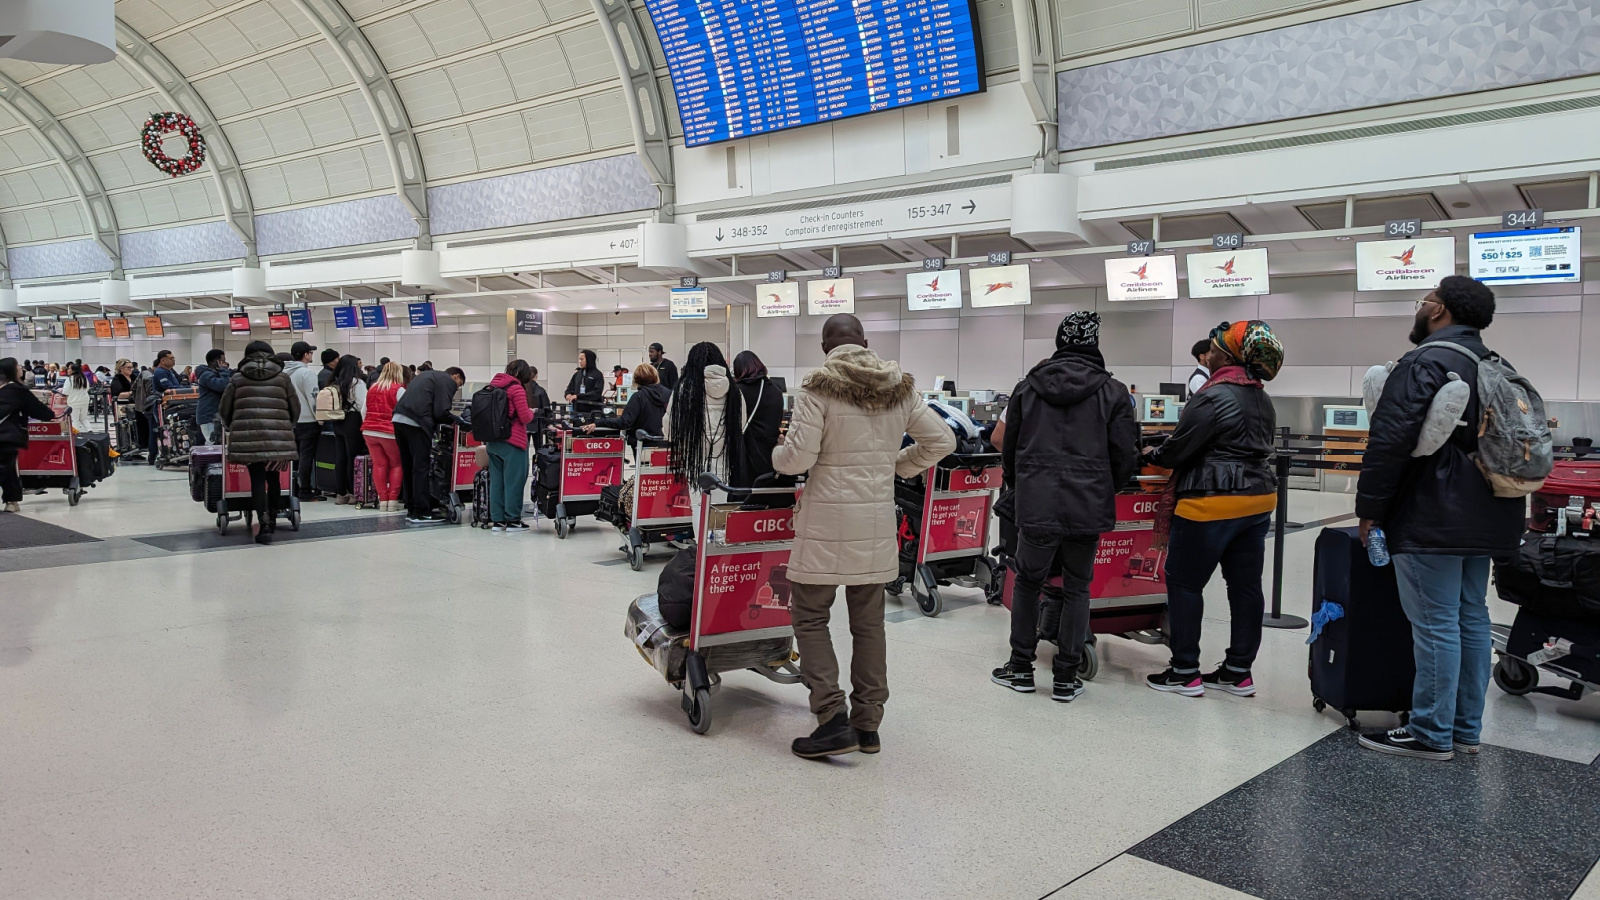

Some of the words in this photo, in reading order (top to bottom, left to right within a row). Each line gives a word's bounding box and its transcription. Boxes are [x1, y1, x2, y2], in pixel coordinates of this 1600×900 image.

[800, 215, 829, 224] Check-in
[832, 210, 864, 220] Counters
[908, 204, 951, 218] 155-347
[1508, 212, 1536, 226] 344
[731, 225, 768, 238] 348-352
[785, 226, 820, 237] Comptoirs
[822, 219, 883, 233] d'enregistrement
[1390, 222, 1415, 234] 345
[1216, 235, 1238, 246] 346
[1131, 242, 1149, 253] 347
[925, 259, 940, 268] 349
[991, 254, 1006, 263] 348
[825, 268, 838, 276] 350
[965, 475, 982, 484] CIBC
[1134, 501, 1159, 513] CIBC
[754, 518, 785, 532] CIBC
[1101, 538, 1116, 547] free
[1118, 538, 1133, 546] cart
[1101, 548, 1114, 557] get
[1116, 548, 1130, 556] you
[711, 564, 718, 574] A
[721, 564, 740, 572] free
[742, 561, 760, 571] cart
[710, 575, 720, 584] to
[722, 573, 738, 585] get
[740, 573, 756, 583] you
[710, 584, 734, 594] there
